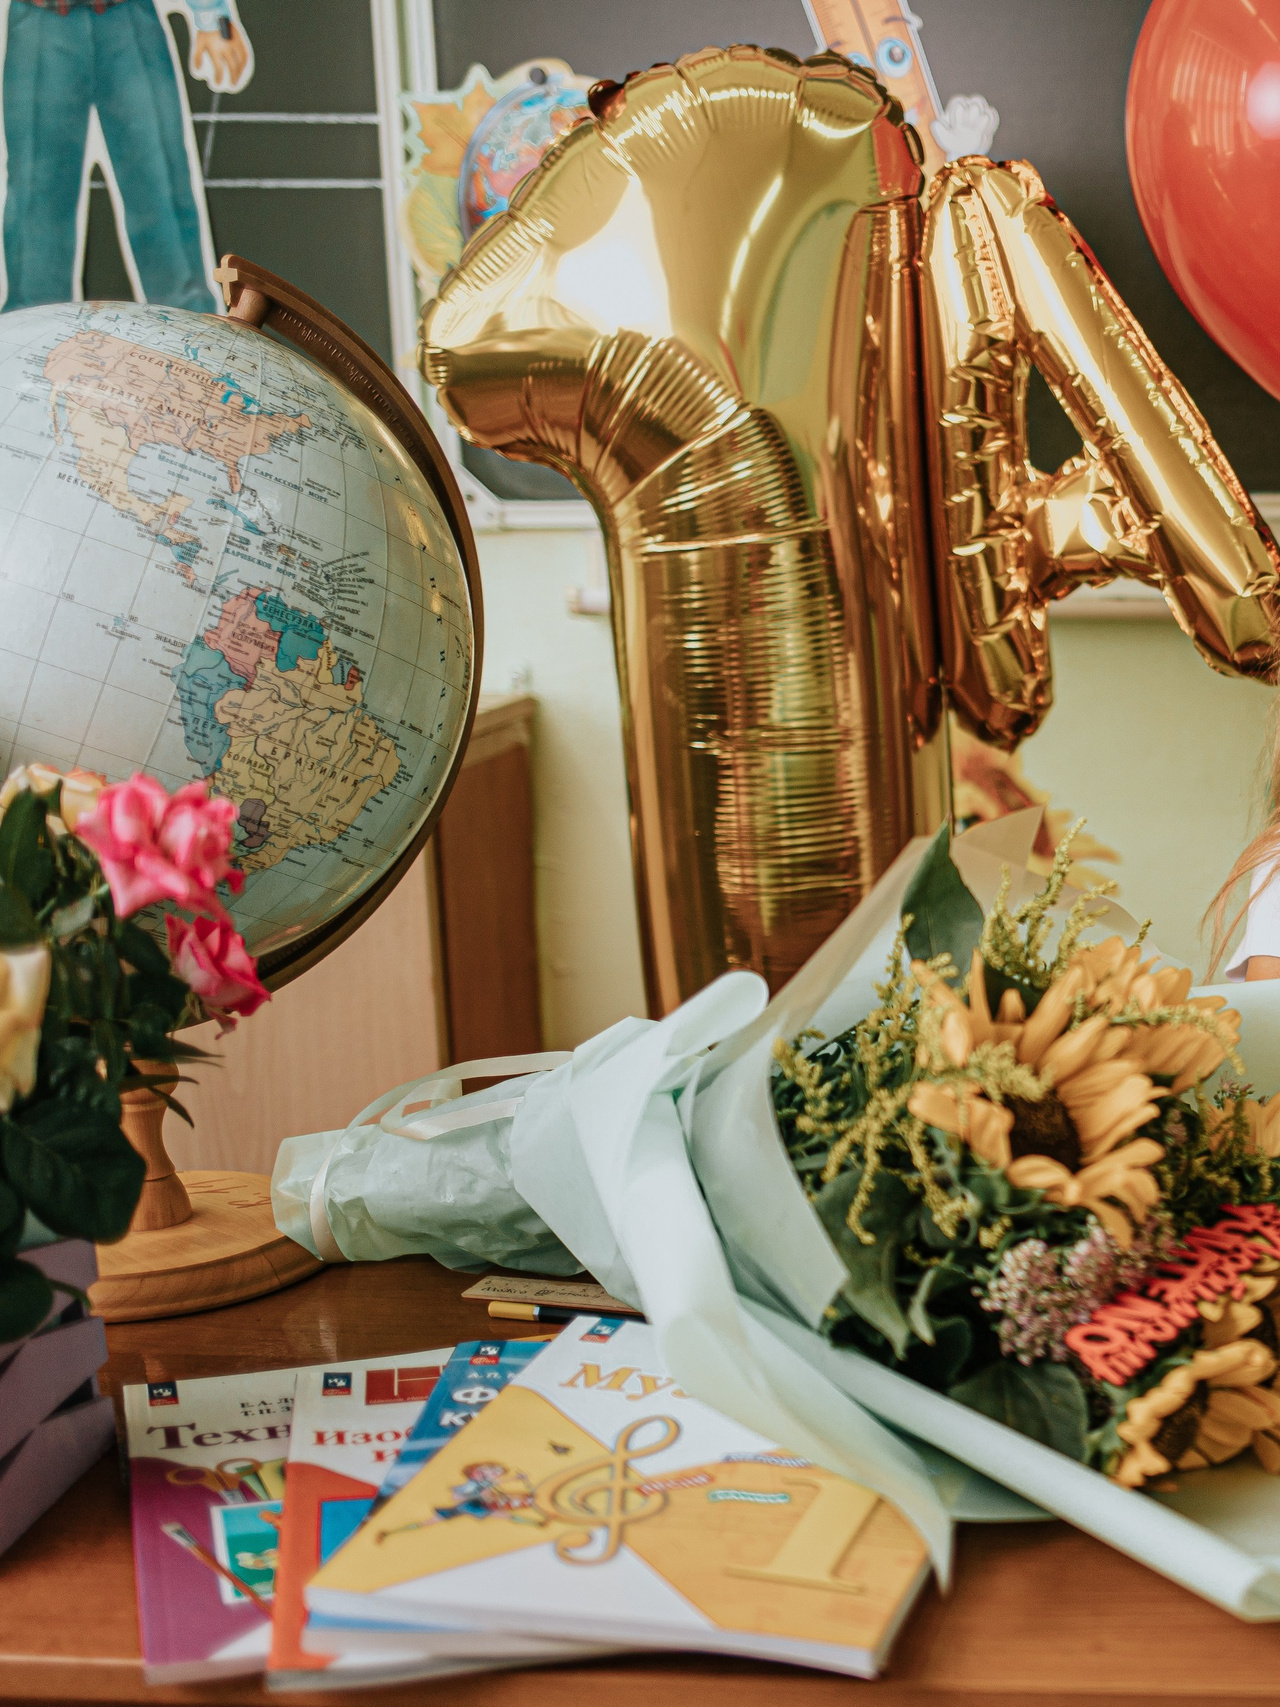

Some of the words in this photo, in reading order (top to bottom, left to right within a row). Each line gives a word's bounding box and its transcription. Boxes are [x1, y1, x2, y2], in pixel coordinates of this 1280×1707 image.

[97, 384, 145, 403] ШТАТЫ
[156, 404, 219, 430] АМЕРИКИ
[57, 471, 110, 496] МЕКСИКА
[254, 461, 304, 493] САРГАССОВО
[308, 490, 329, 503] МОРЕ
[263, 604, 315, 630] ВЕНЕСУЭЛА
[192, 717, 226, 734] ПЕРУ
[227, 751, 272, 772] БОЛИВИЯ
[271, 746, 360, 788] БРАЗИЛИЯ
[559, 1363, 692, 1400] Му
[147, 1422, 292, 1450] Техн
